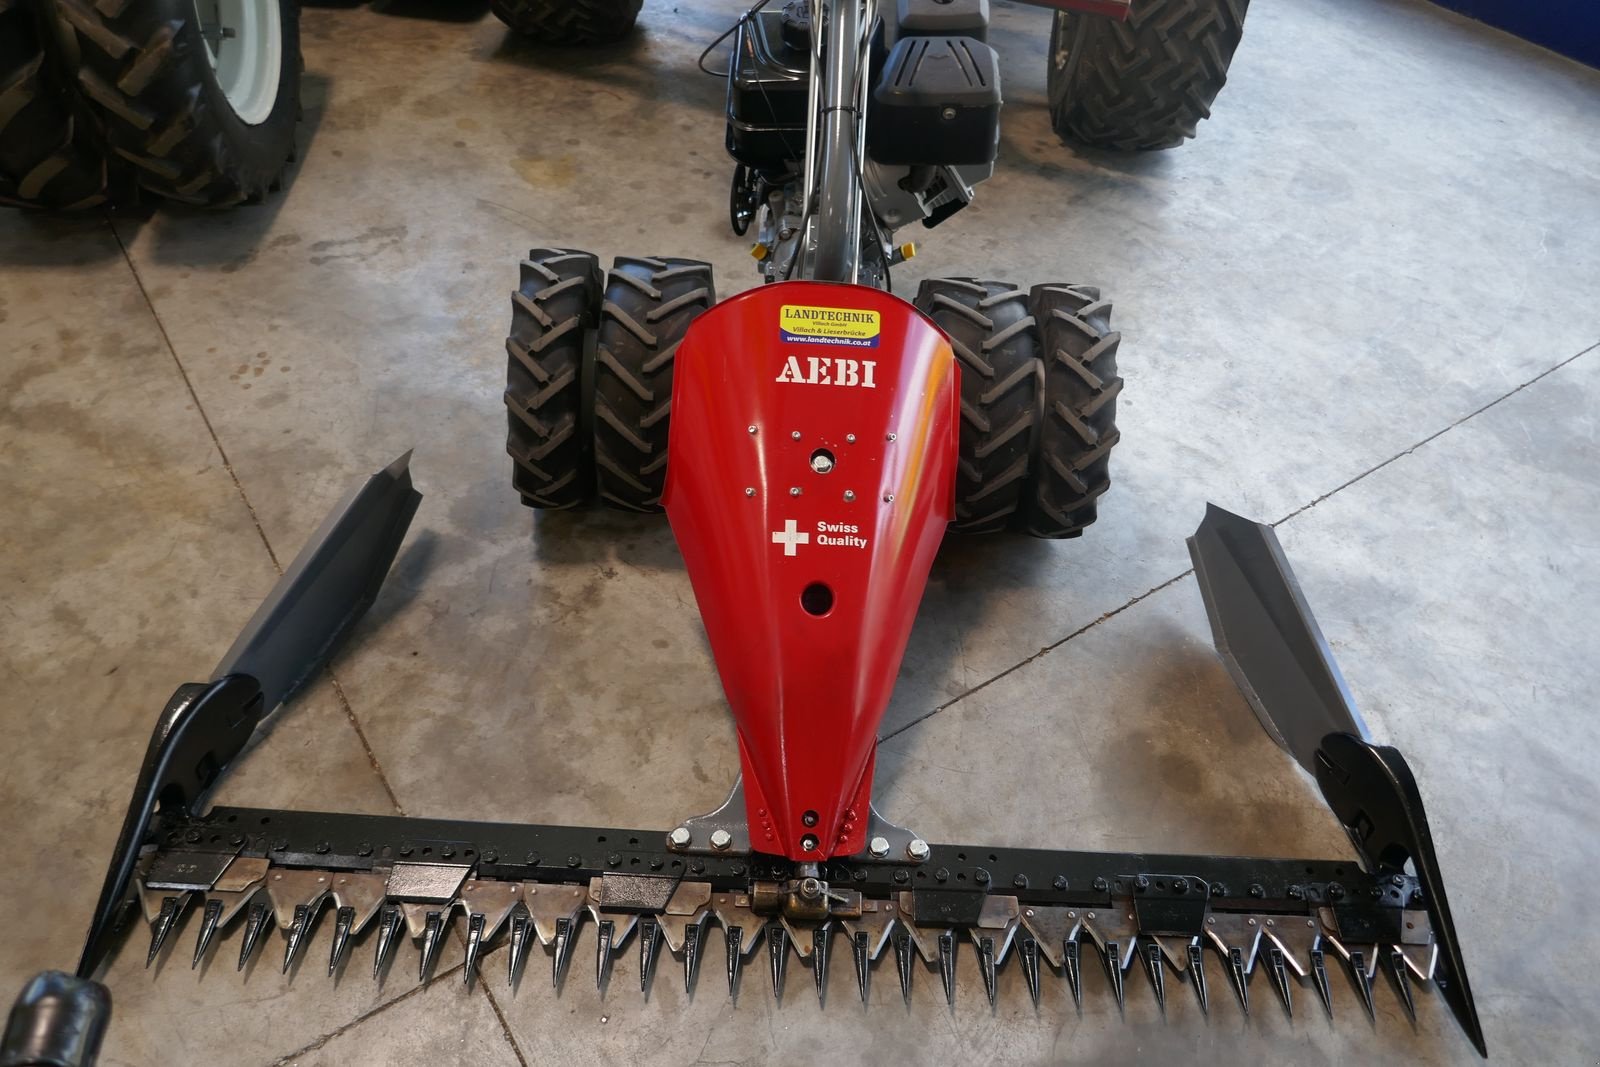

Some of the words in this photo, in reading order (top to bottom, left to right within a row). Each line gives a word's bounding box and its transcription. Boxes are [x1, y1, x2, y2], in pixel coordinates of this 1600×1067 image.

[785, 308, 874, 324] LANDTECHNIK
[786, 336, 872, 346] www.landtechnik.co.at
[776, 356, 876, 388] AEBI
[817, 521, 858, 534] Swiss
[816, 534, 868, 548] Quality
